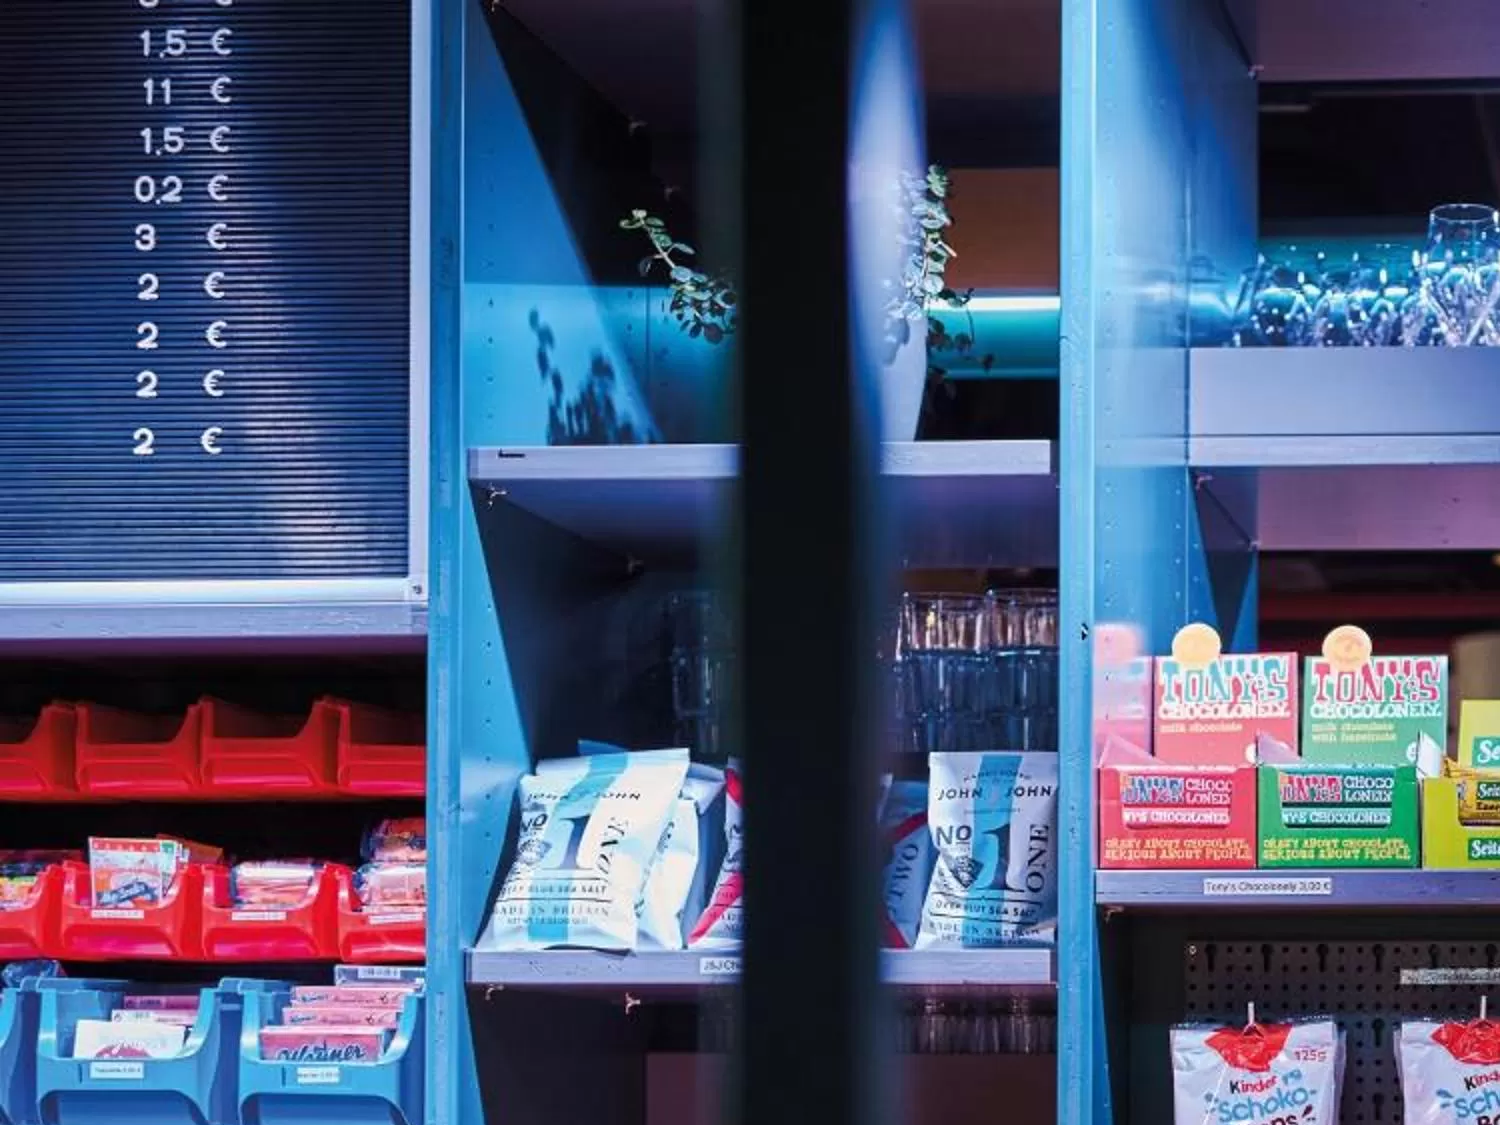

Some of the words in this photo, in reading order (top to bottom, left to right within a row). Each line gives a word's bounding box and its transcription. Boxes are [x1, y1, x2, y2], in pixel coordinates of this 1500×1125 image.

[210, 27, 232, 56] €
[143, 78, 171, 105] 11
[209, 75, 232, 103] €
[209, 126, 231, 153] €
[207, 175, 229, 201] €
[135, 223, 156, 251] 3
[206, 223, 228, 250] €
[137, 273, 159, 300] 2
[204, 271, 225, 299] €
[136, 322, 159, 349] 2
[205, 320, 227, 348] €
[136, 370, 158, 398] 2
[203, 369, 225, 397] €
[133, 427, 155, 455] 2
[201, 426, 223, 454] €
[938, 788, 983, 800] JOHN
[1007, 785, 1052, 797] JOHN
[1025, 823, 1049, 893] ONE
